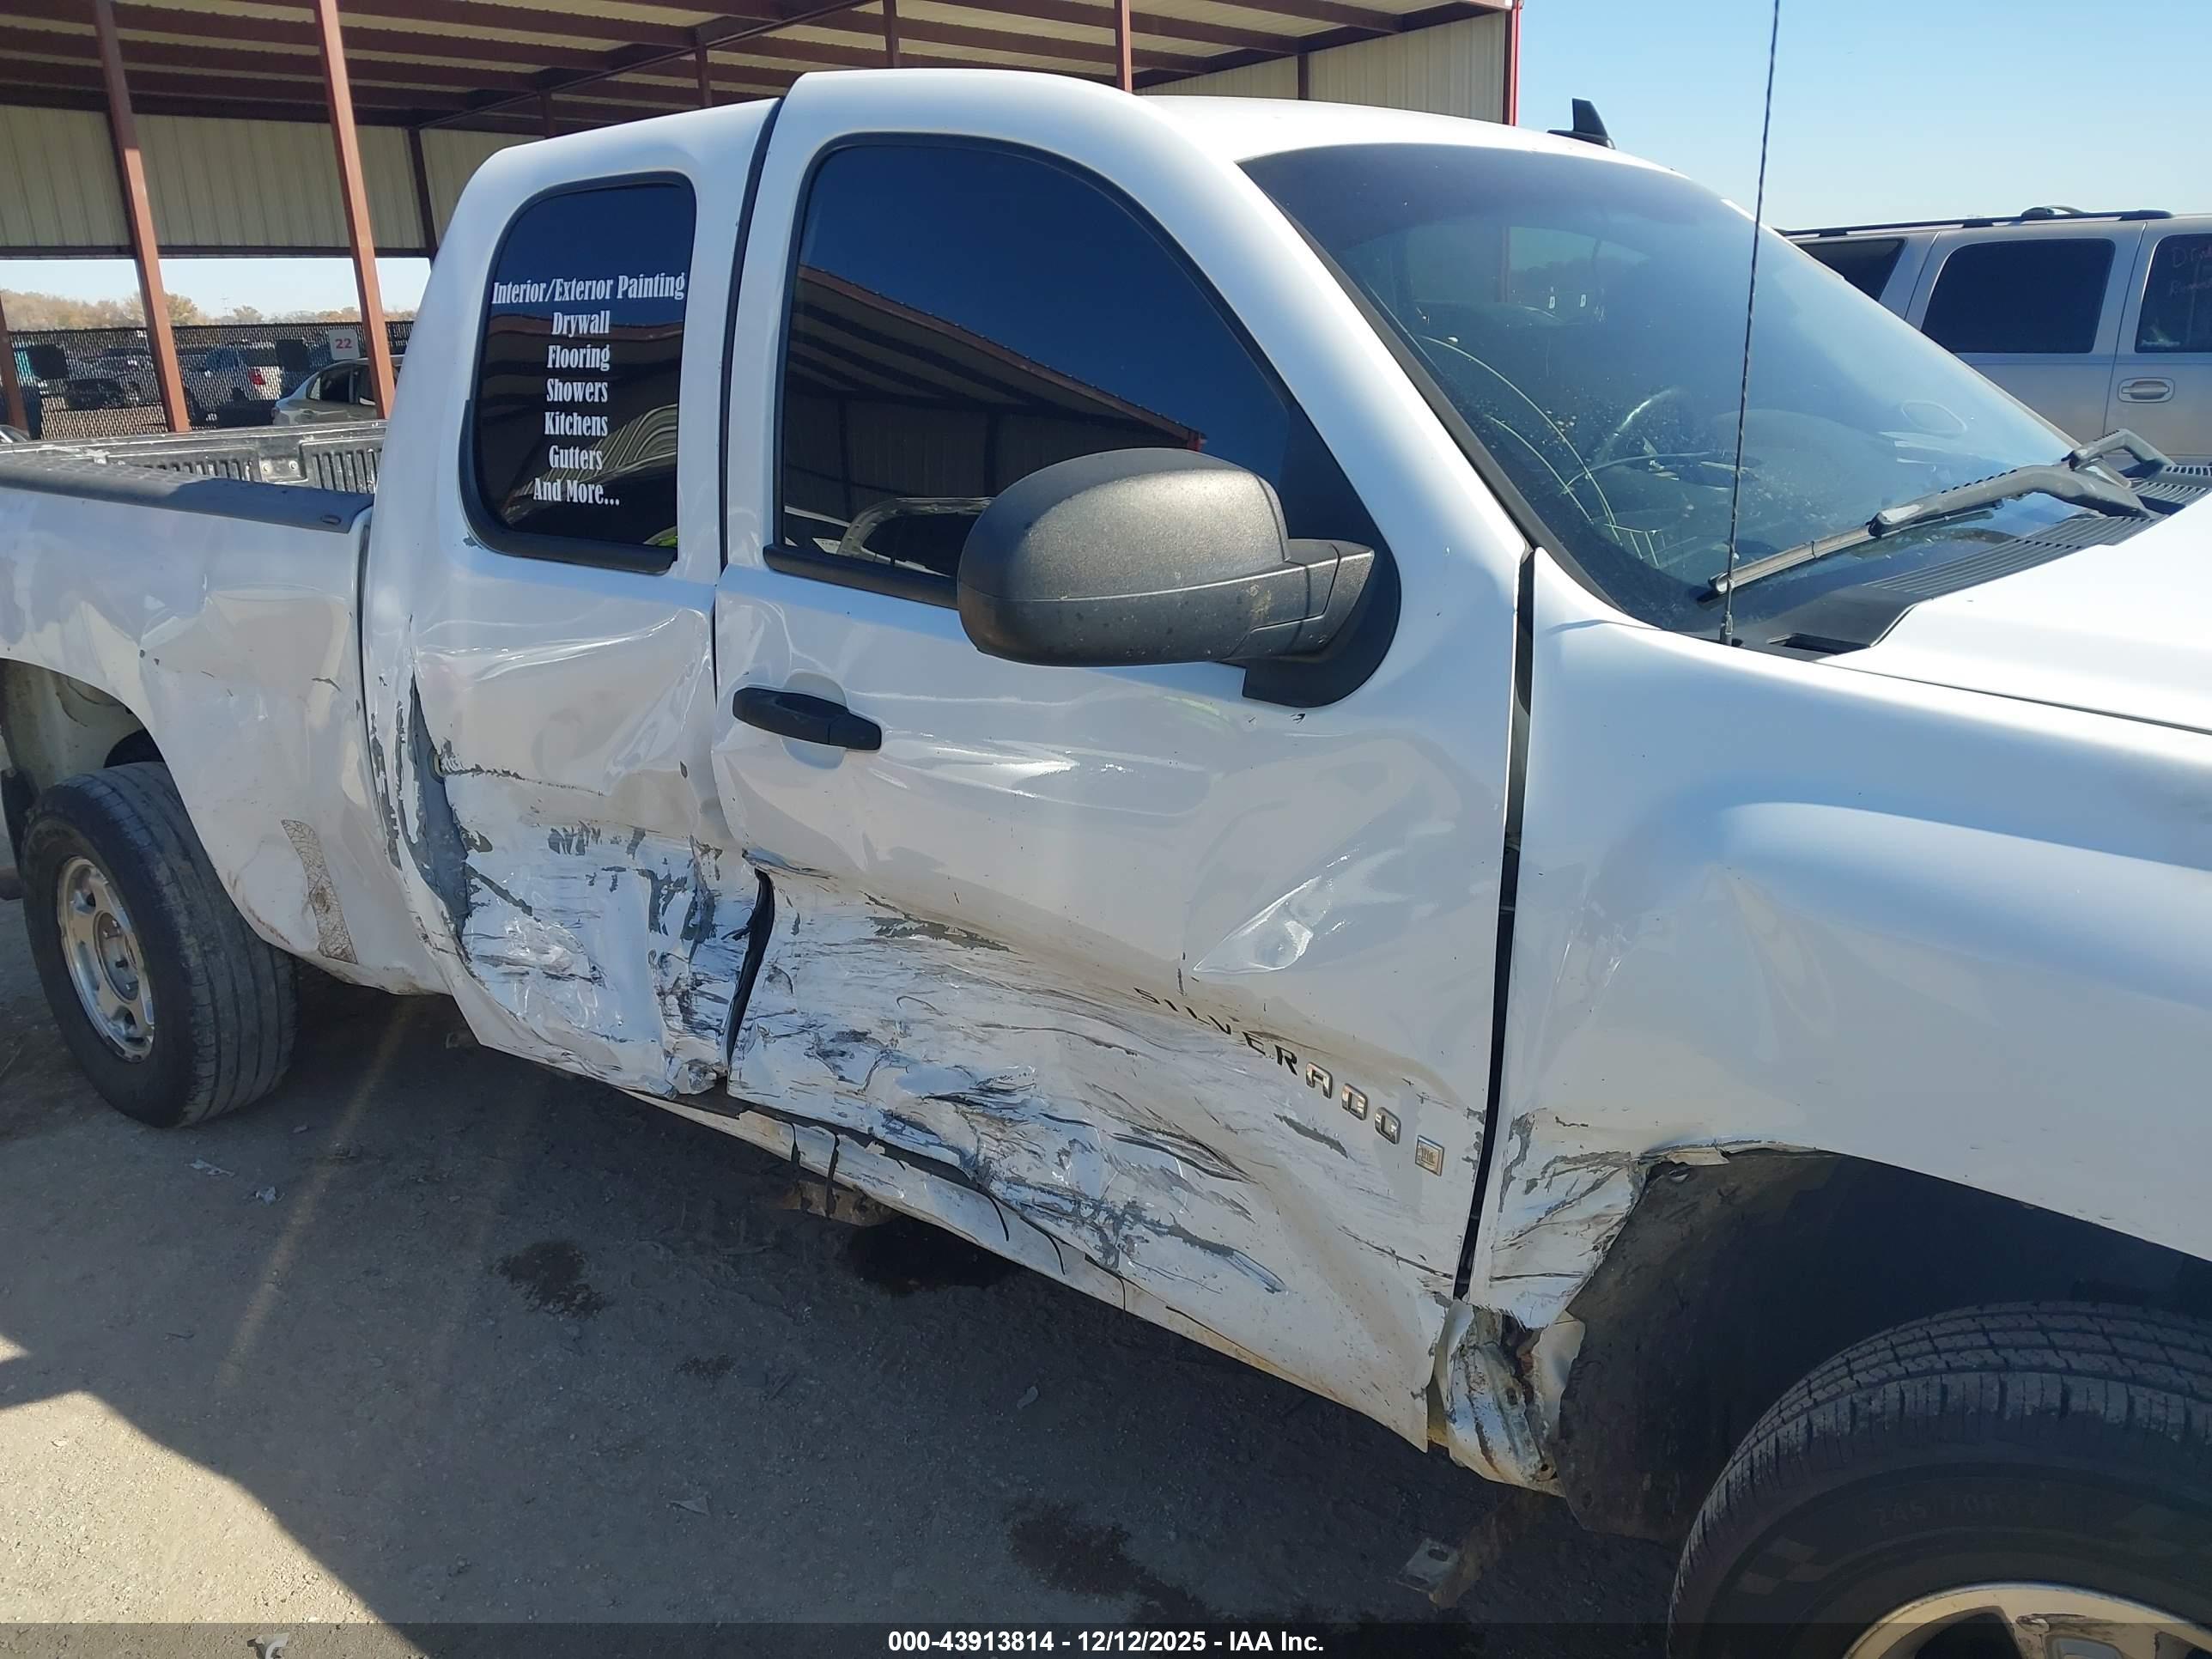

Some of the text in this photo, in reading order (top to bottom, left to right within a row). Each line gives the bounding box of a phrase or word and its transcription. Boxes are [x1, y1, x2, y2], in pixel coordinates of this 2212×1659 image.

[491, 271, 686, 304] Interior/Exterior Painting
[551, 310, 611, 338] Drywall
[335, 337, 353, 349] 22
[546, 344, 611, 371] Flooring
[546, 378, 608, 403] Showers
[544, 411, 608, 436] Kitchens
[548, 445, 603, 471] Gutters
[532, 477, 620, 507] And More...
